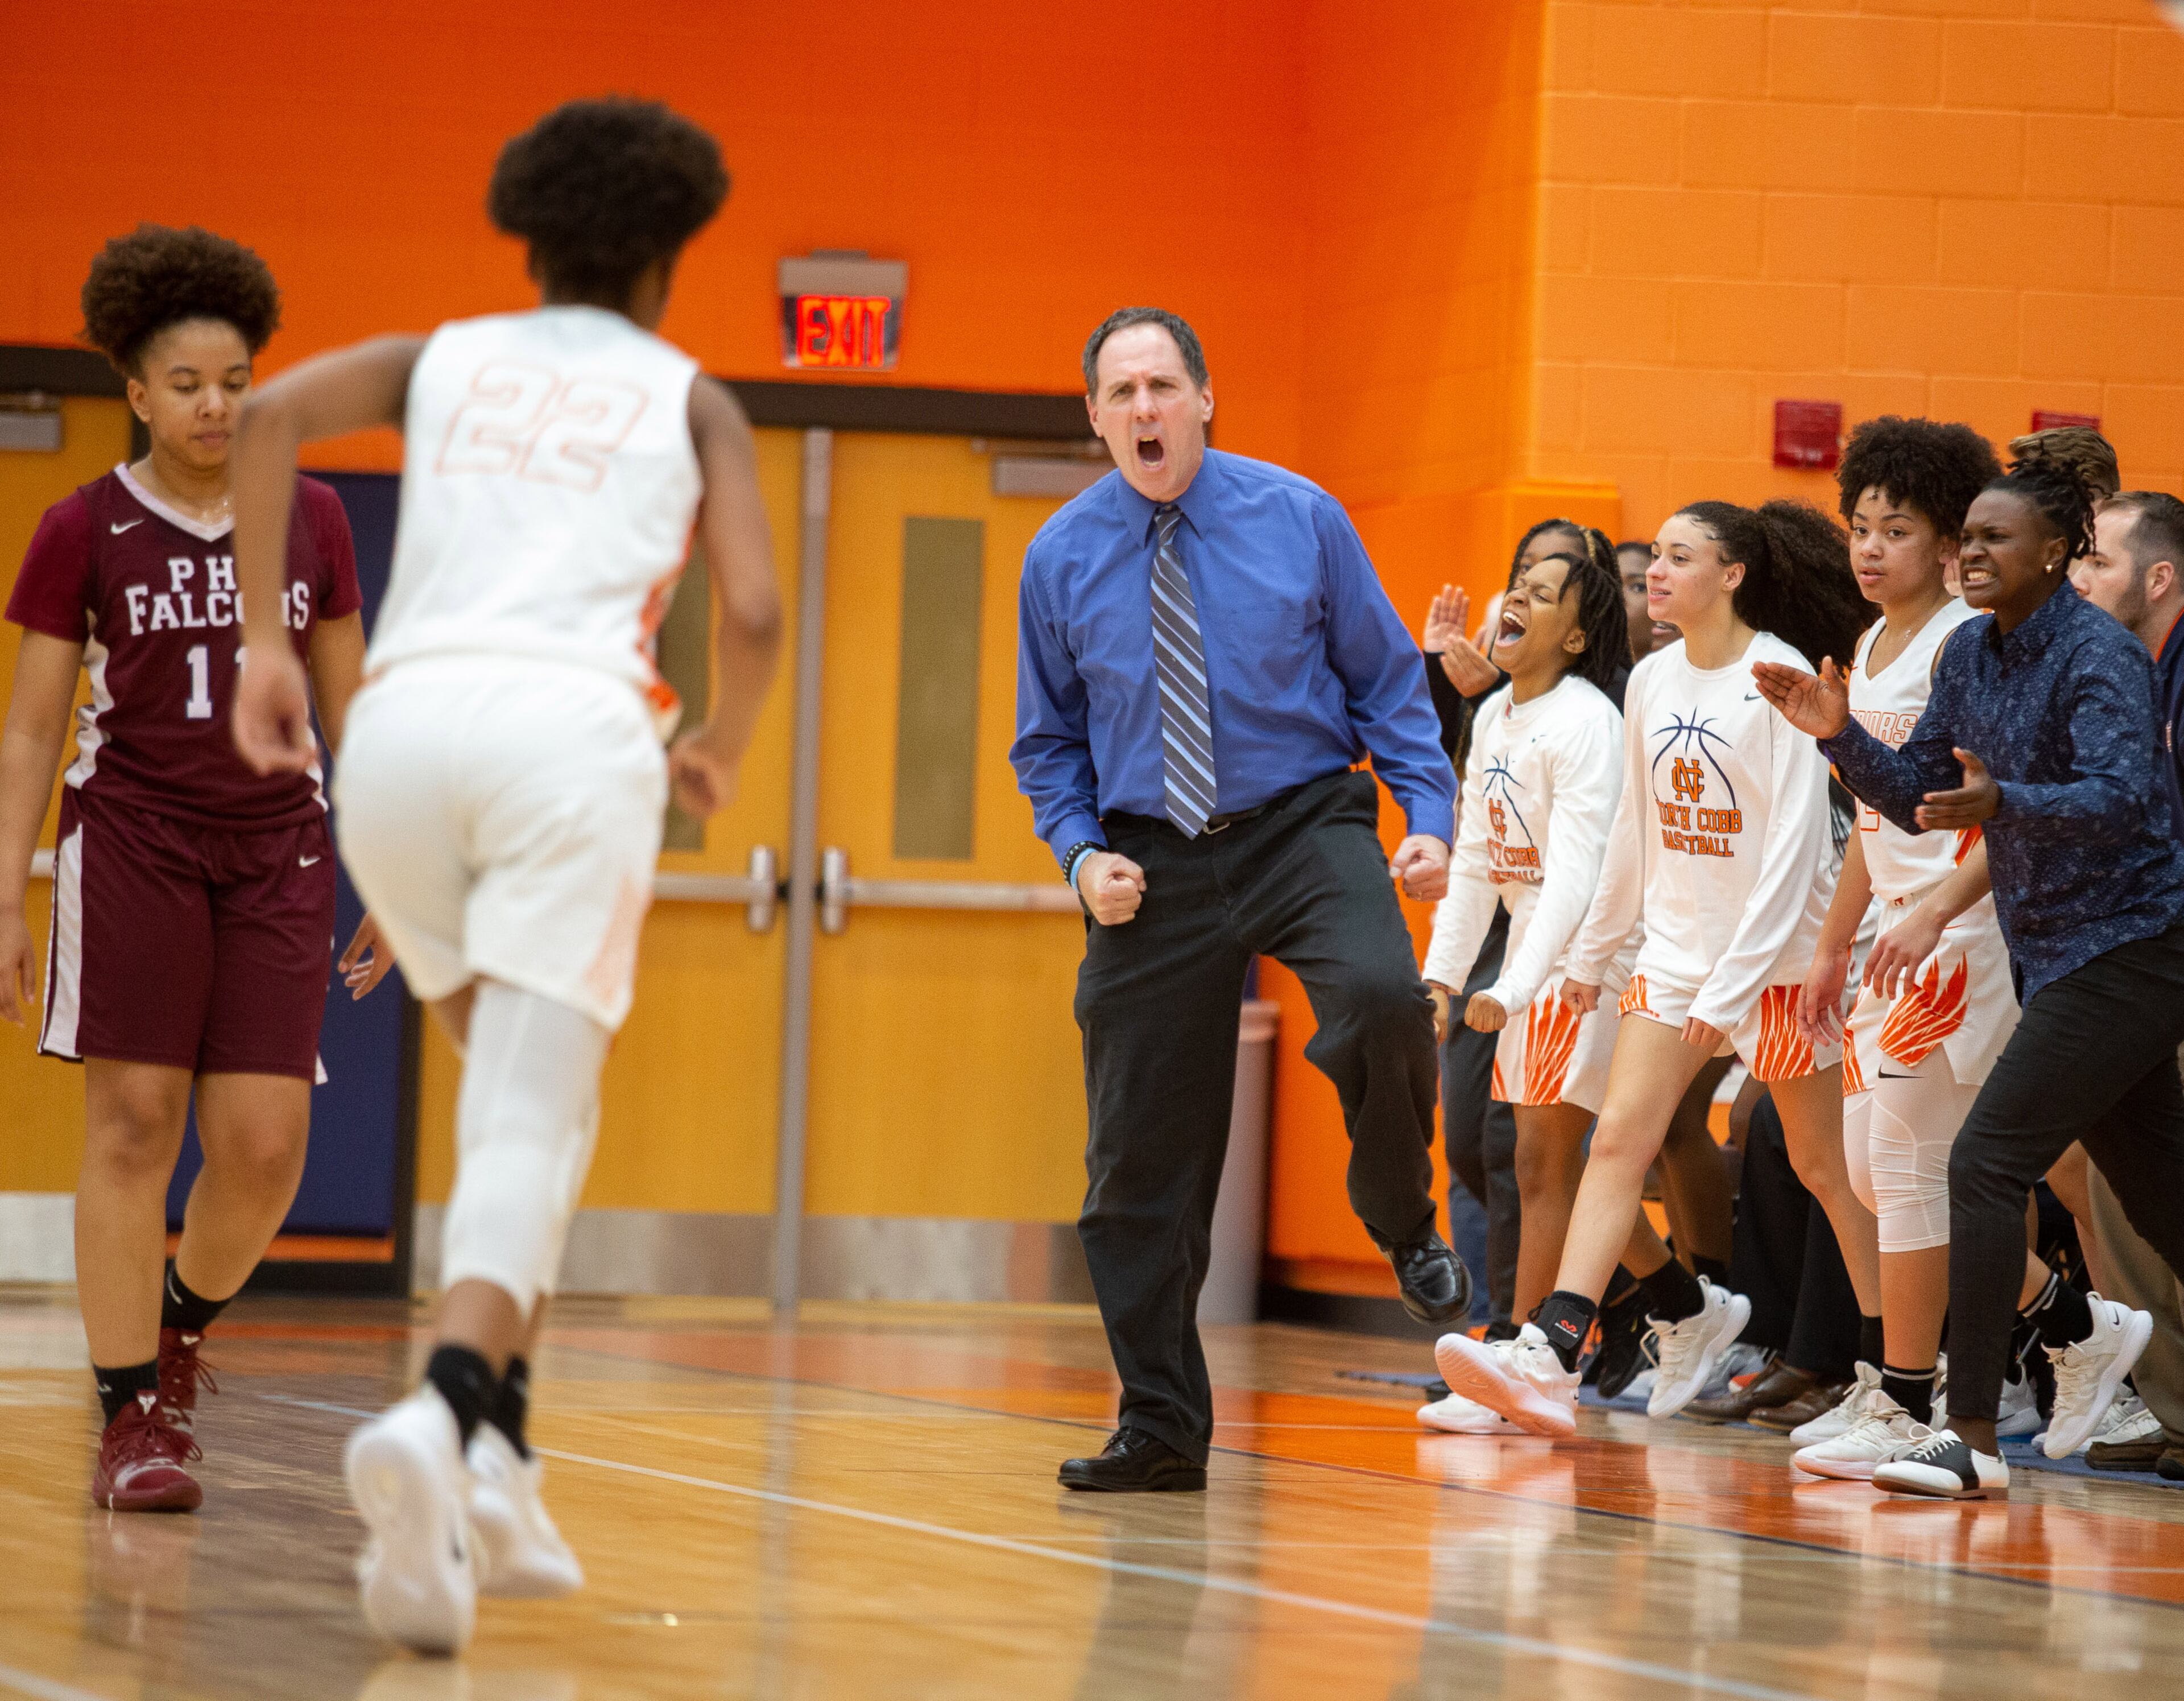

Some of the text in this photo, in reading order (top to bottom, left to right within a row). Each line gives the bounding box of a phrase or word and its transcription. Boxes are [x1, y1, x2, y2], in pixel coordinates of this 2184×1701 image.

[797, 294, 891, 367] EXIT
[433, 356, 651, 496] 22
[1697, 807, 1743, 833] COBB
